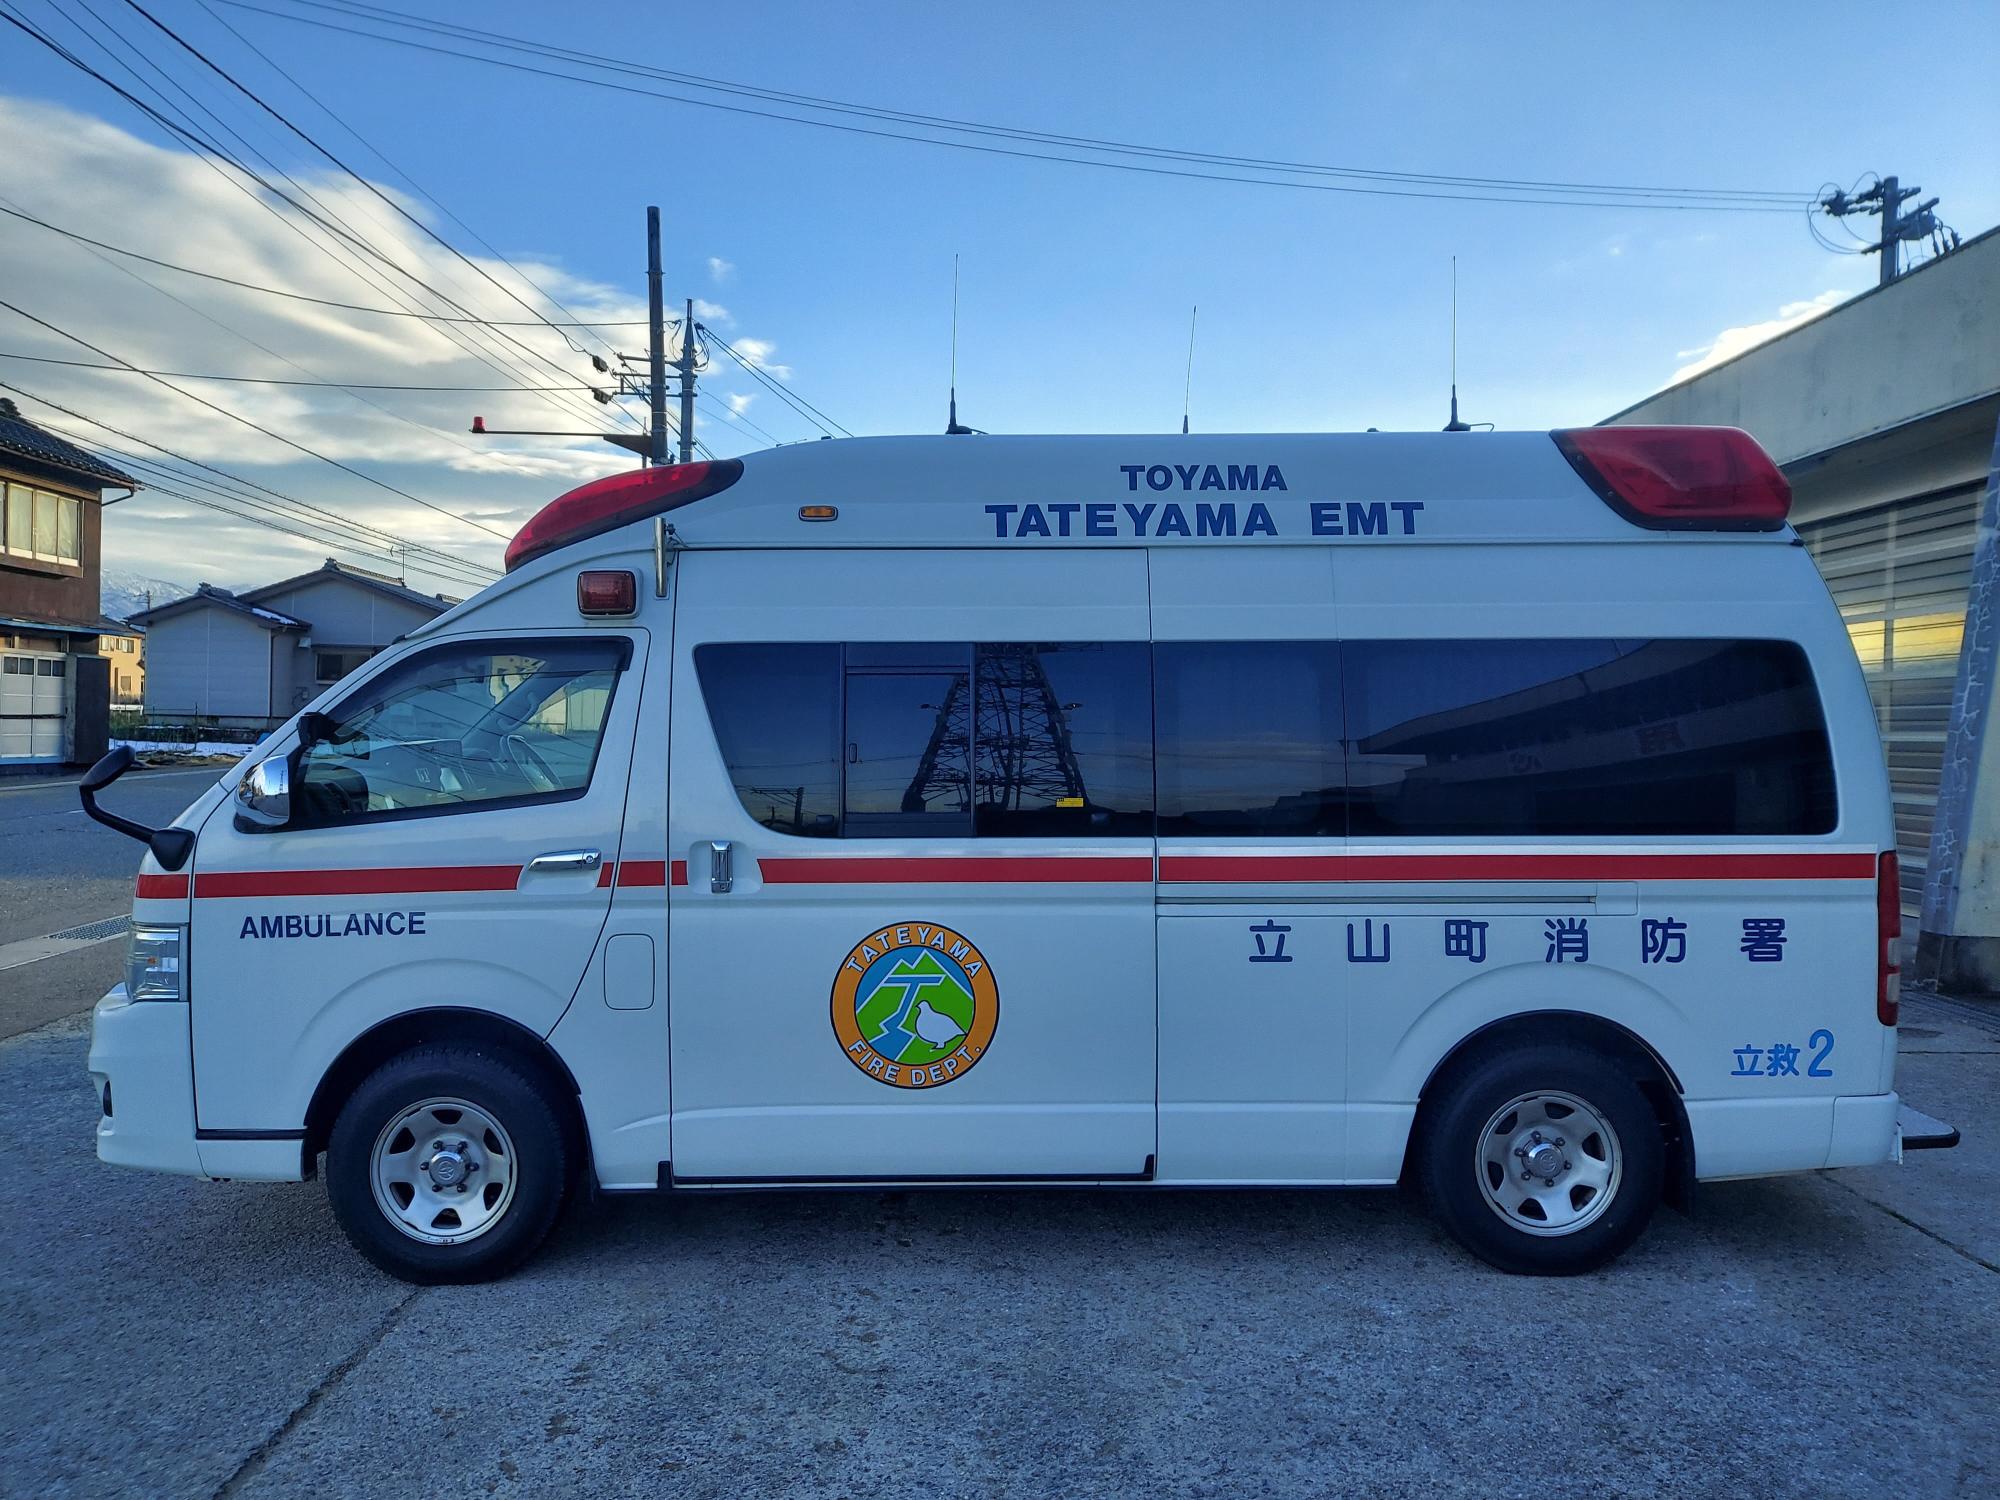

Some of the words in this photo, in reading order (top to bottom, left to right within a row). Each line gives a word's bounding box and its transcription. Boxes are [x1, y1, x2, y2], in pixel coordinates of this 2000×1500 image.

[1119, 464, 1289, 492] TOYAMA
[984, 502, 1279, 538] TATEYAMA
[1309, 501, 1425, 536] EMT
[240, 911, 426, 940] AMBULANCE
[846, 926, 983, 979] TATEYAMA
[848, 1039, 900, 1083] FIRE
[911, 1045, 982, 1086] DEPT.
